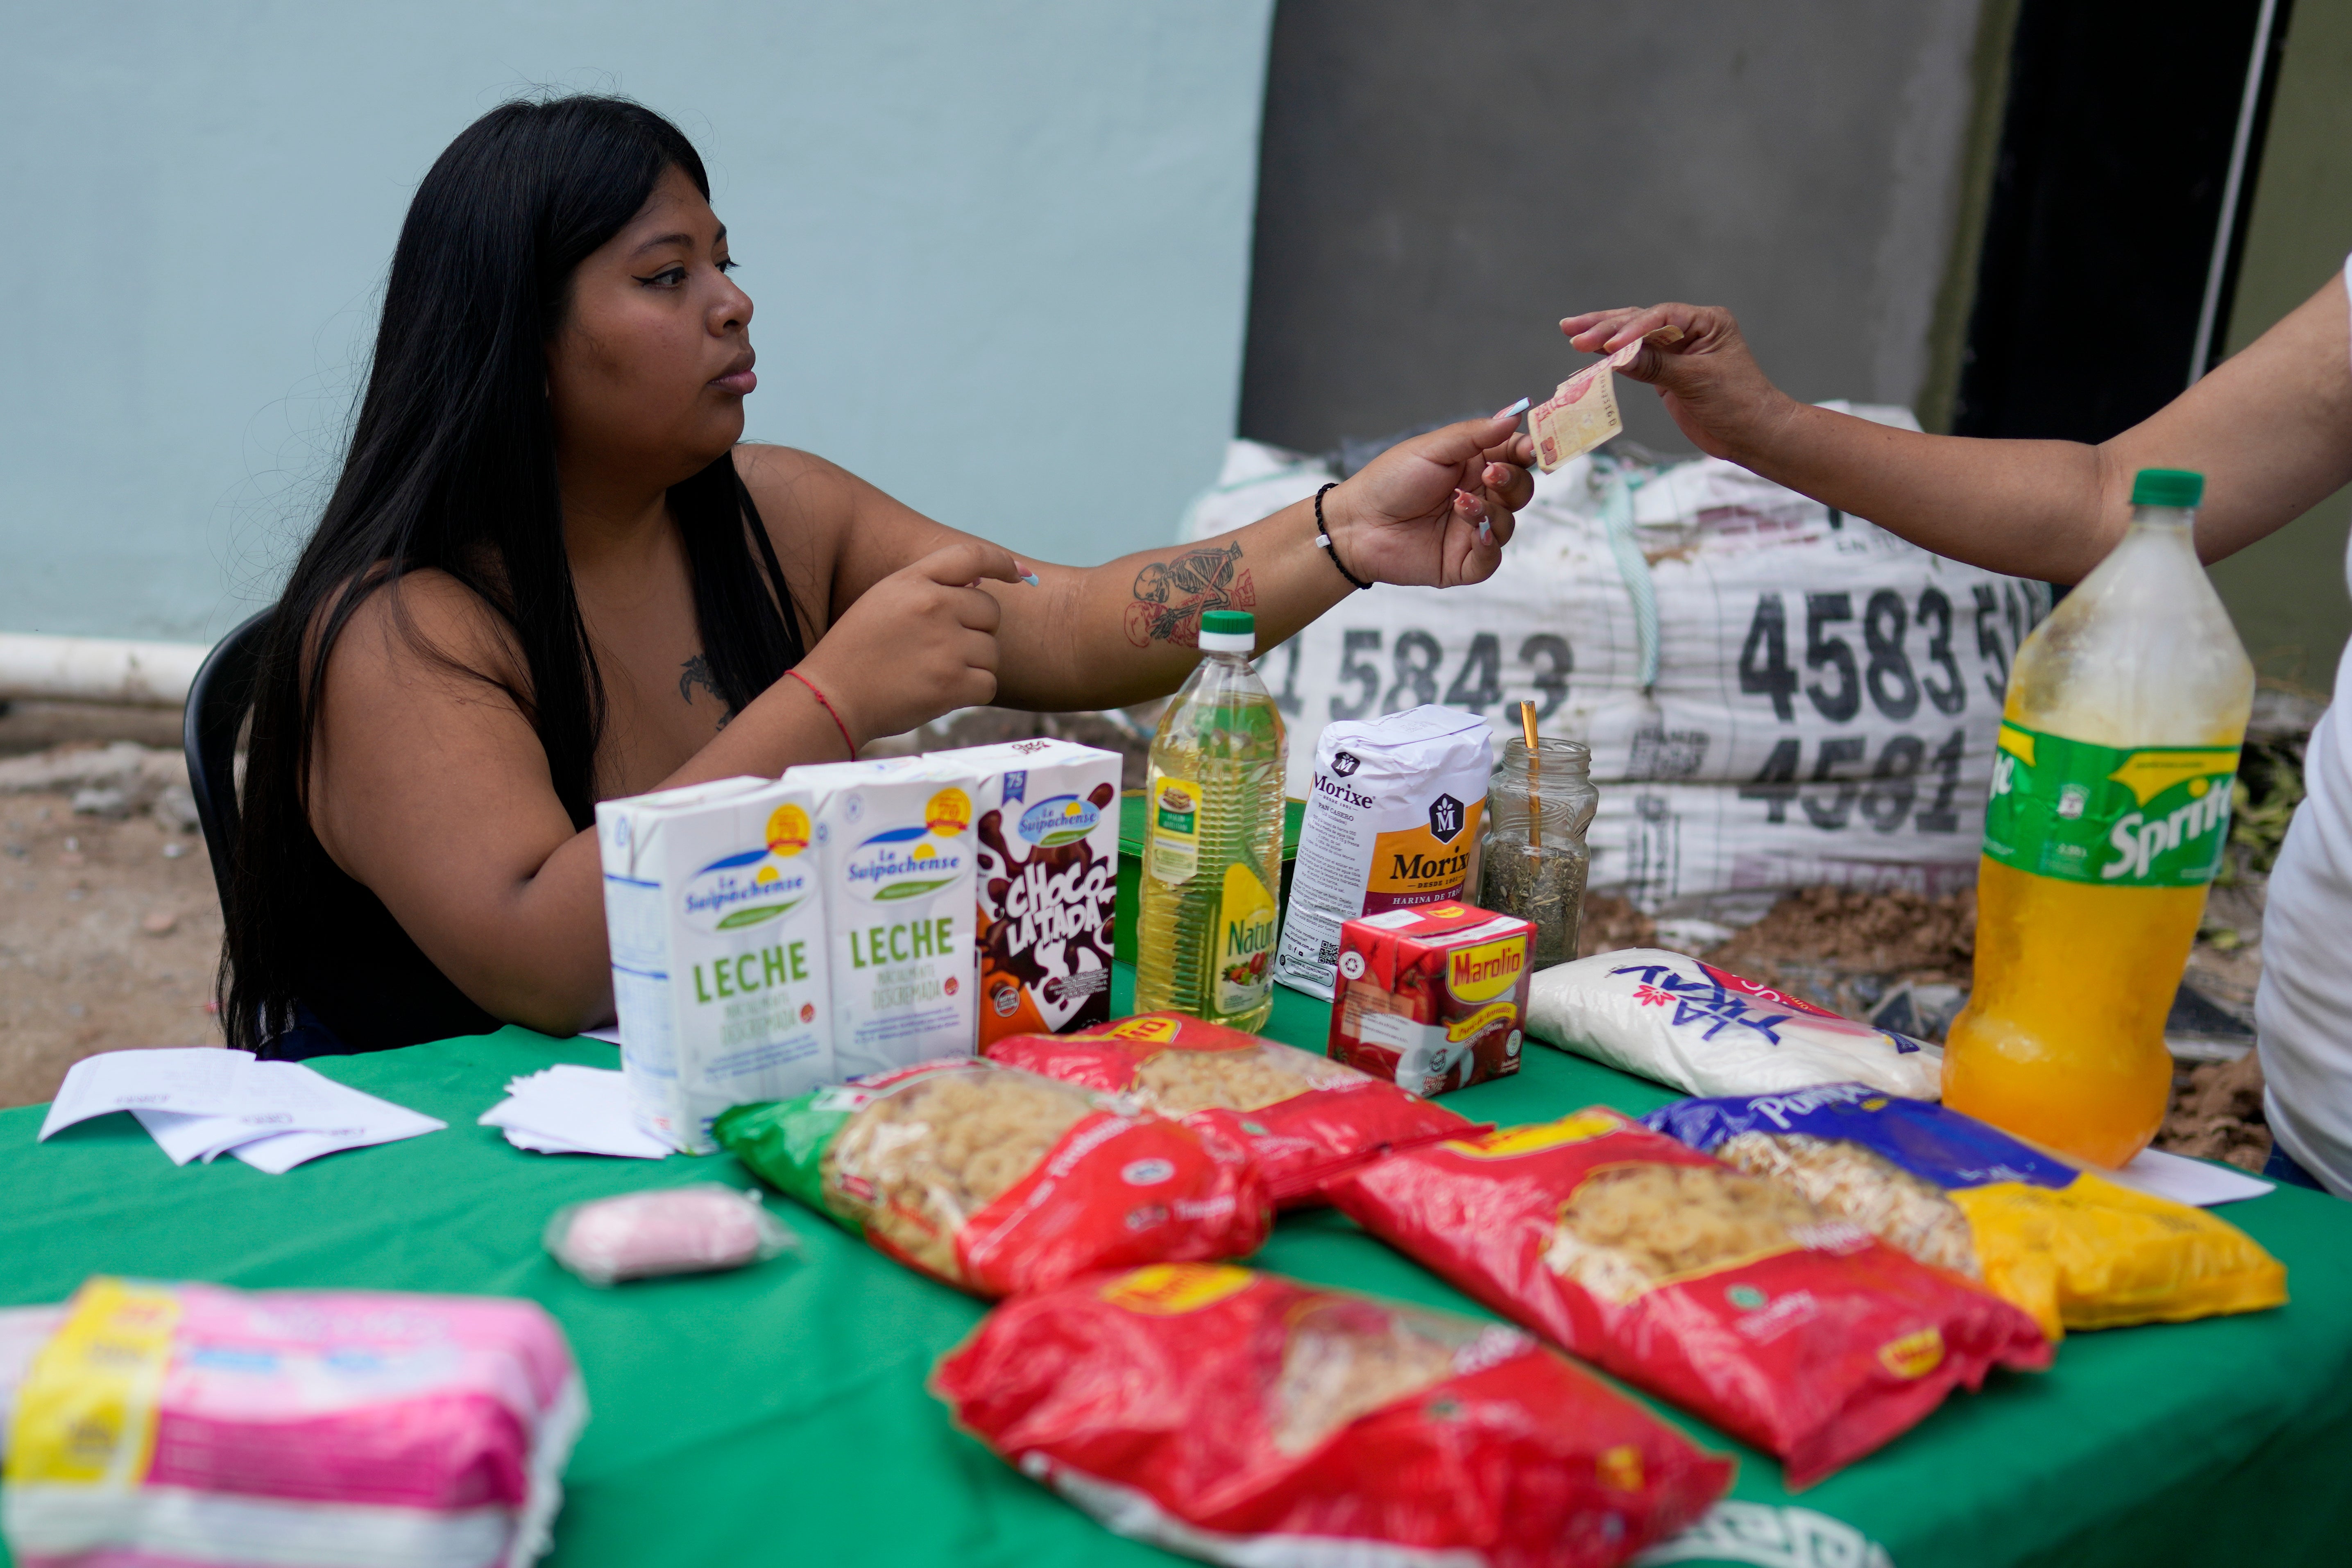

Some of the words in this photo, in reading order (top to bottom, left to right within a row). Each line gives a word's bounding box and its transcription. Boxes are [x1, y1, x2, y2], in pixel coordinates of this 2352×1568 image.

[1739, 587, 1965, 723] 4583
[1330, 629, 1574, 728] 5843
[1006, 772, 1023, 789] 75
[1738, 727, 1964, 834] 4581
[1318, 802, 1329, 811] PAN
[1330, 808, 1354, 821] CASERO
[1436, 810, 1456, 832] M
[2100, 776, 2234, 880] Sprit
[847, 855, 961, 883] Suipachense
[1389, 845, 1470, 879] Morix
[1392, 896, 1431, 905] HARINA
[1417, 880, 1443, 888] DESDE
[850, 917, 954, 970] LECHE
[1006, 895, 1103, 958] LATADA
[1228, 919, 1272, 957] Natur
[693, 940, 809, 1004] LECHE
[1454, 947, 1520, 987] Marolio
